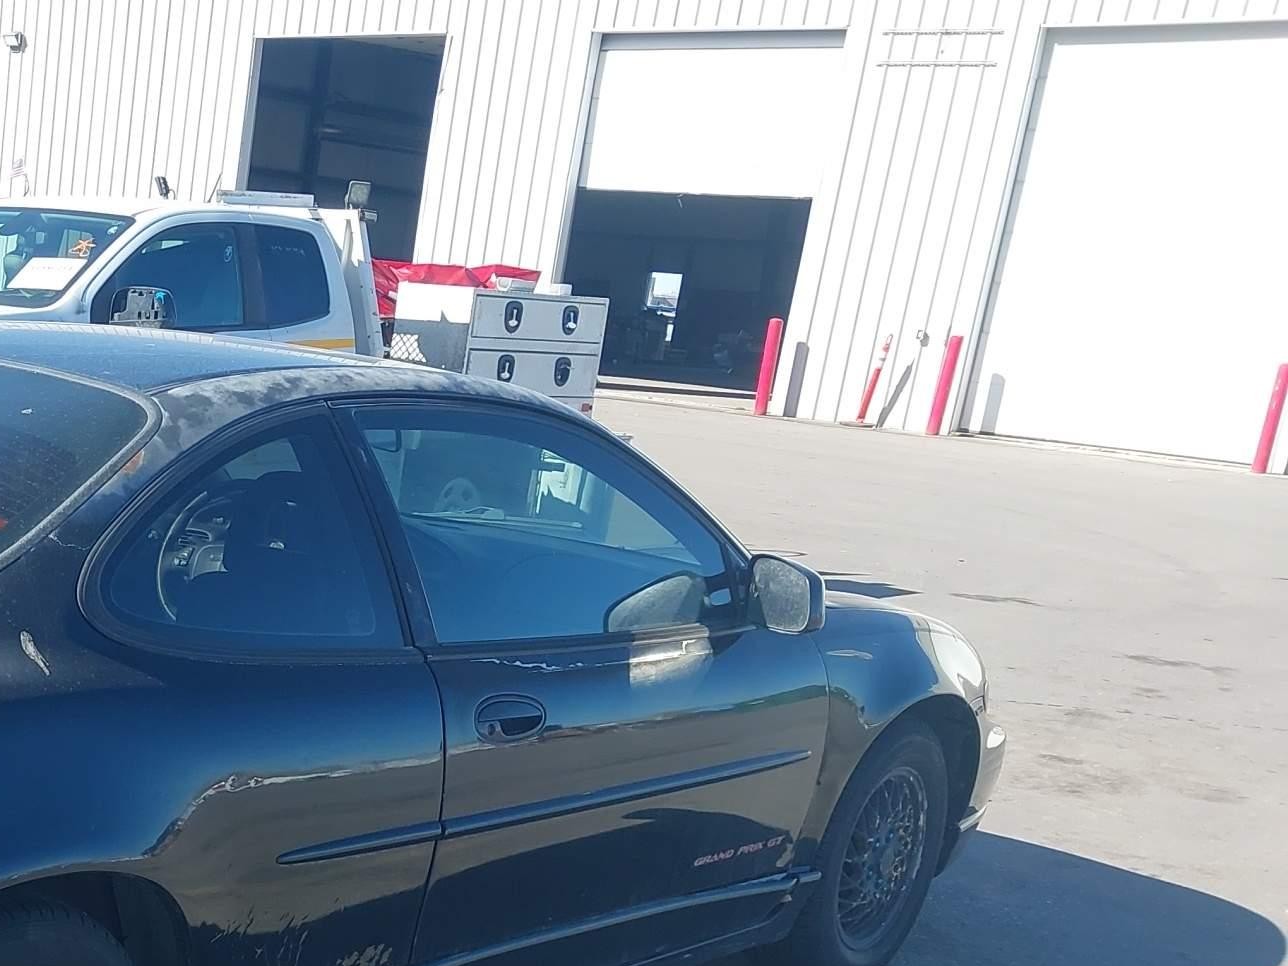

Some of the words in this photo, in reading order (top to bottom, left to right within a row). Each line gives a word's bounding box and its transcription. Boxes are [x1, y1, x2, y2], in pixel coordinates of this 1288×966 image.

[694, 848, 735, 867] GRAND
[736, 840, 766, 856] PRIX
[767, 834, 786, 848] GT
